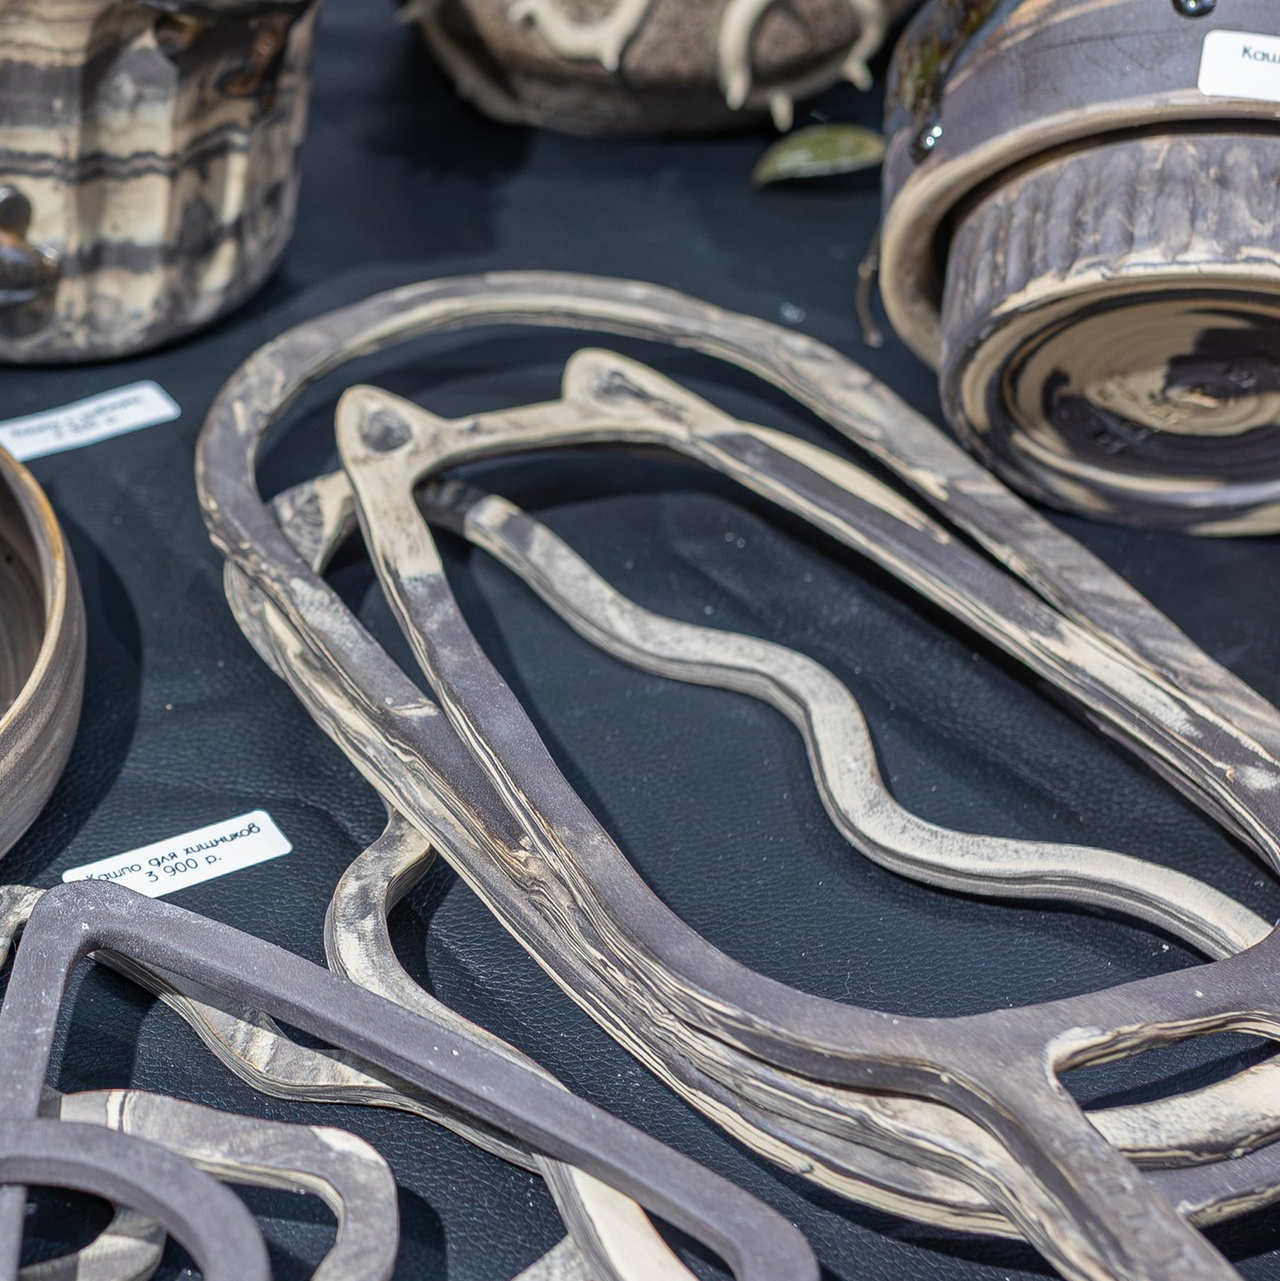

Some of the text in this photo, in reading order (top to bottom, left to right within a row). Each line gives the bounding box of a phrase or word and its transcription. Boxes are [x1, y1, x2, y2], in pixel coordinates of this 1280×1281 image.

[145, 855, 222, 883] 3 900 р.
[148, 852, 178, 867] для
